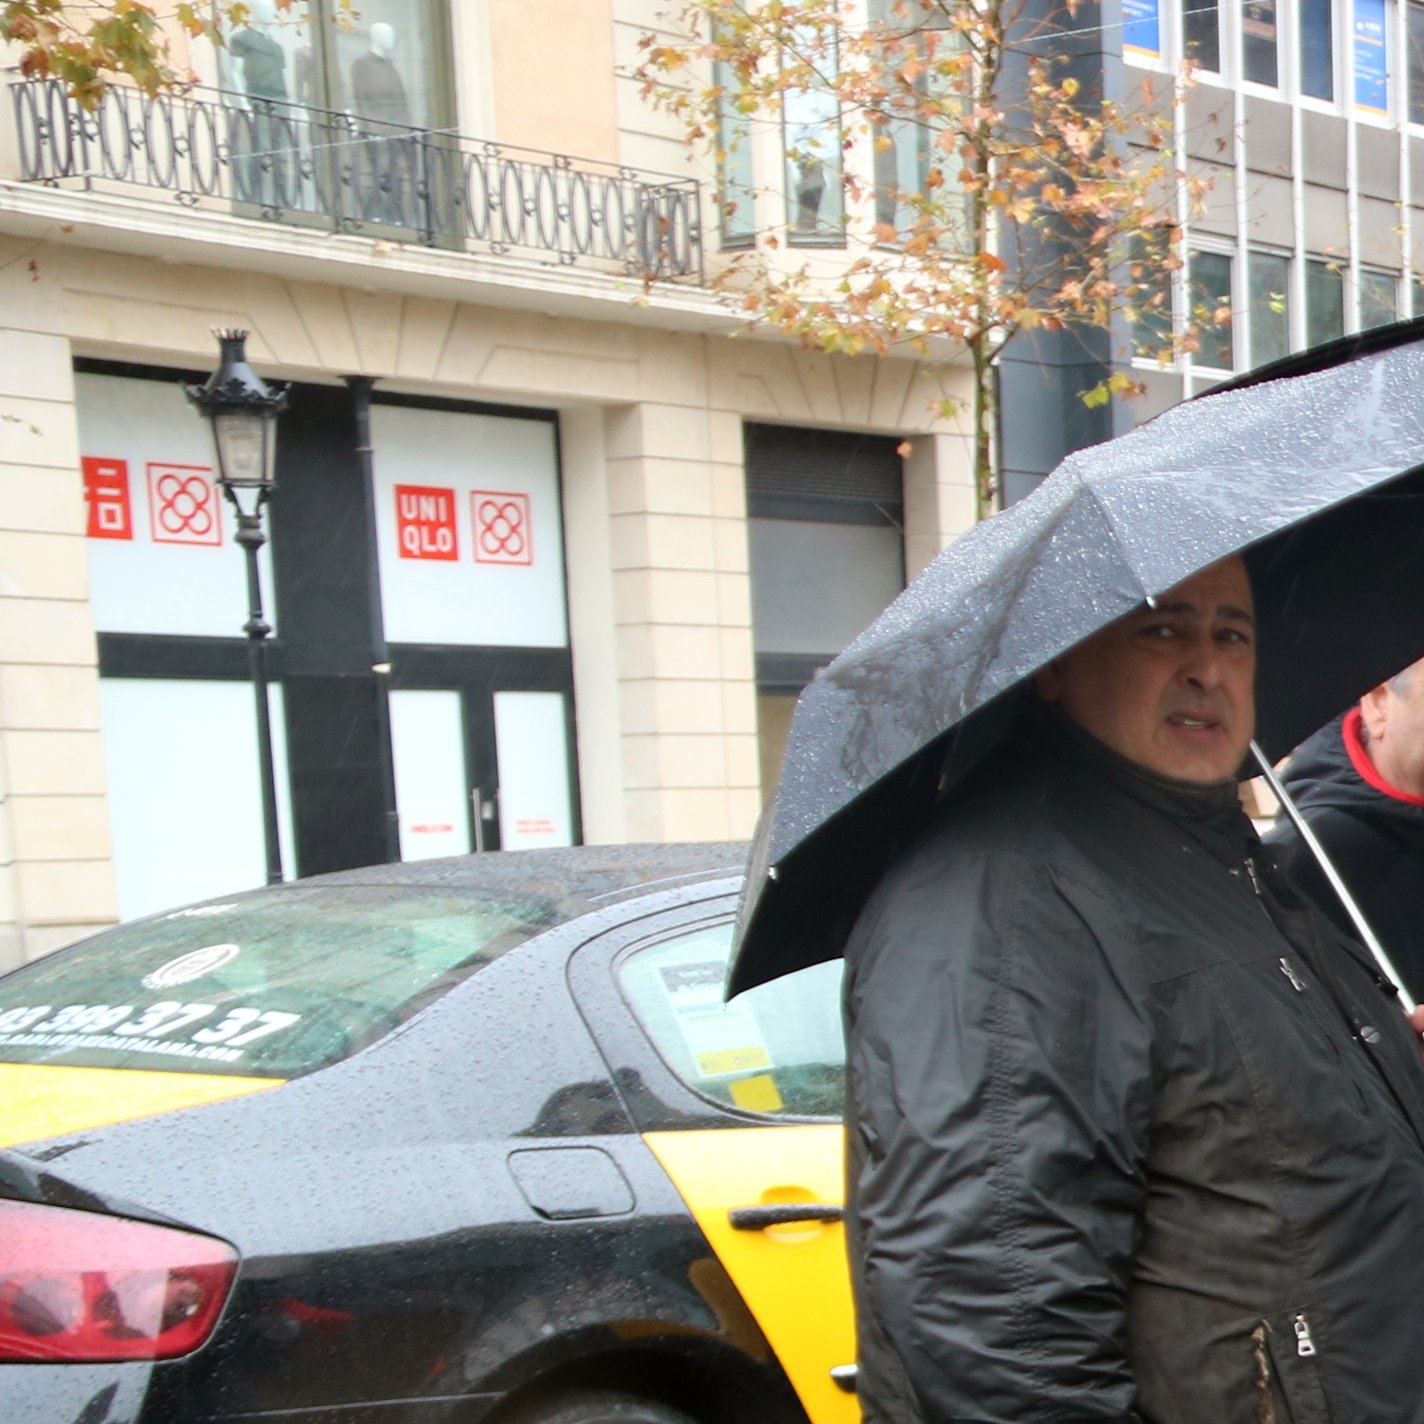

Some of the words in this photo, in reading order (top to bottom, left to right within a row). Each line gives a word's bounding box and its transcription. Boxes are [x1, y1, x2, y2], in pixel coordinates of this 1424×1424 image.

[399, 494, 448, 522] UNI
[402, 524, 453, 556] QLO
[31, 1004, 134, 1033] 399
[112, 1001, 218, 1037] 37
[191, 1007, 302, 1047] 37
